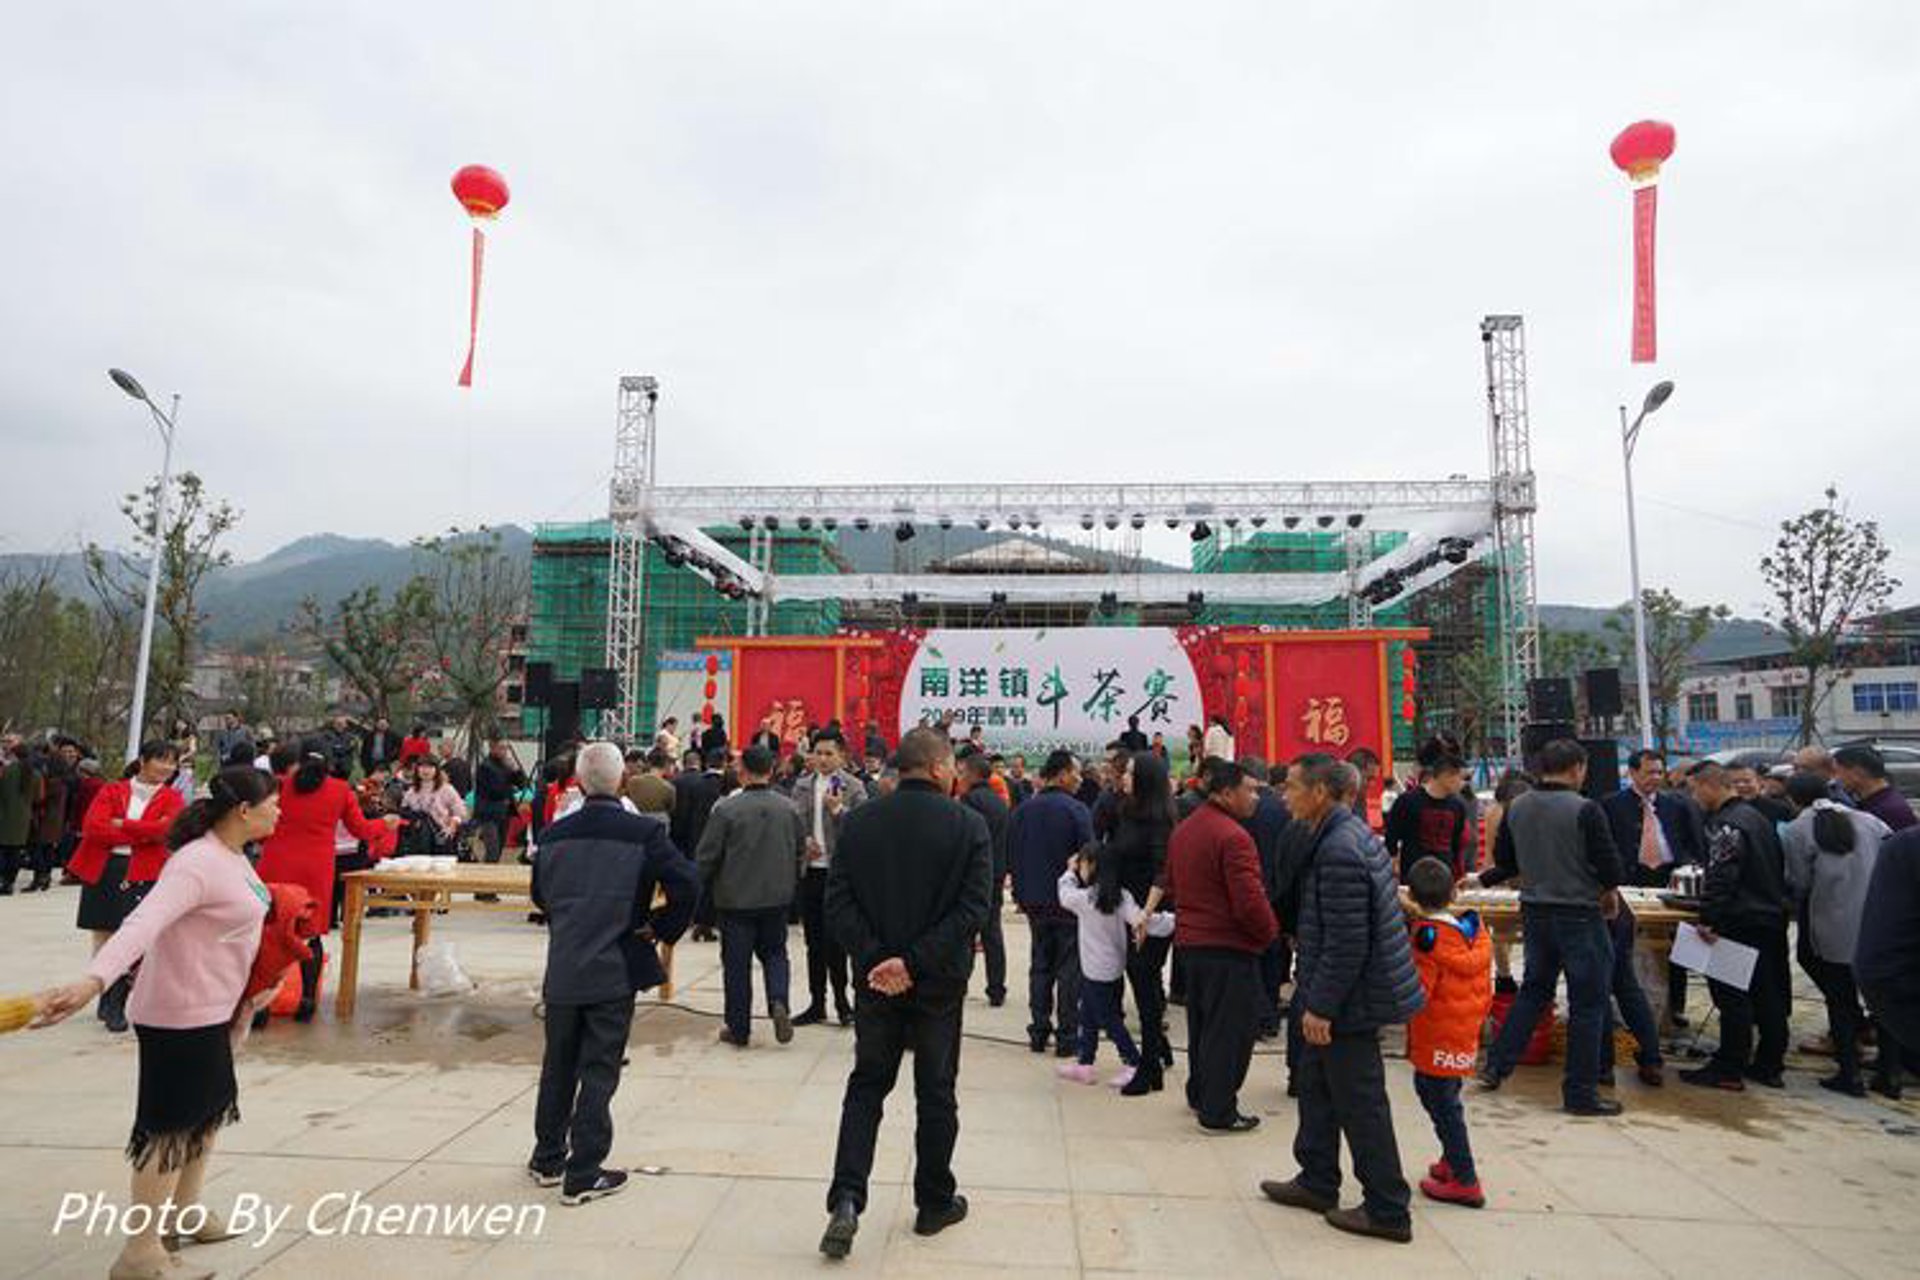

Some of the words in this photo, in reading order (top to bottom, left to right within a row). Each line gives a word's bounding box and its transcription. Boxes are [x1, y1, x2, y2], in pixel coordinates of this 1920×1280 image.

[920, 667, 1030, 698] 南洋镇
[1036, 664, 1178, 729] 斗茶赛
[921, 706, 1028, 727] 209年春节
[1301, 698, 1349, 746] 福
